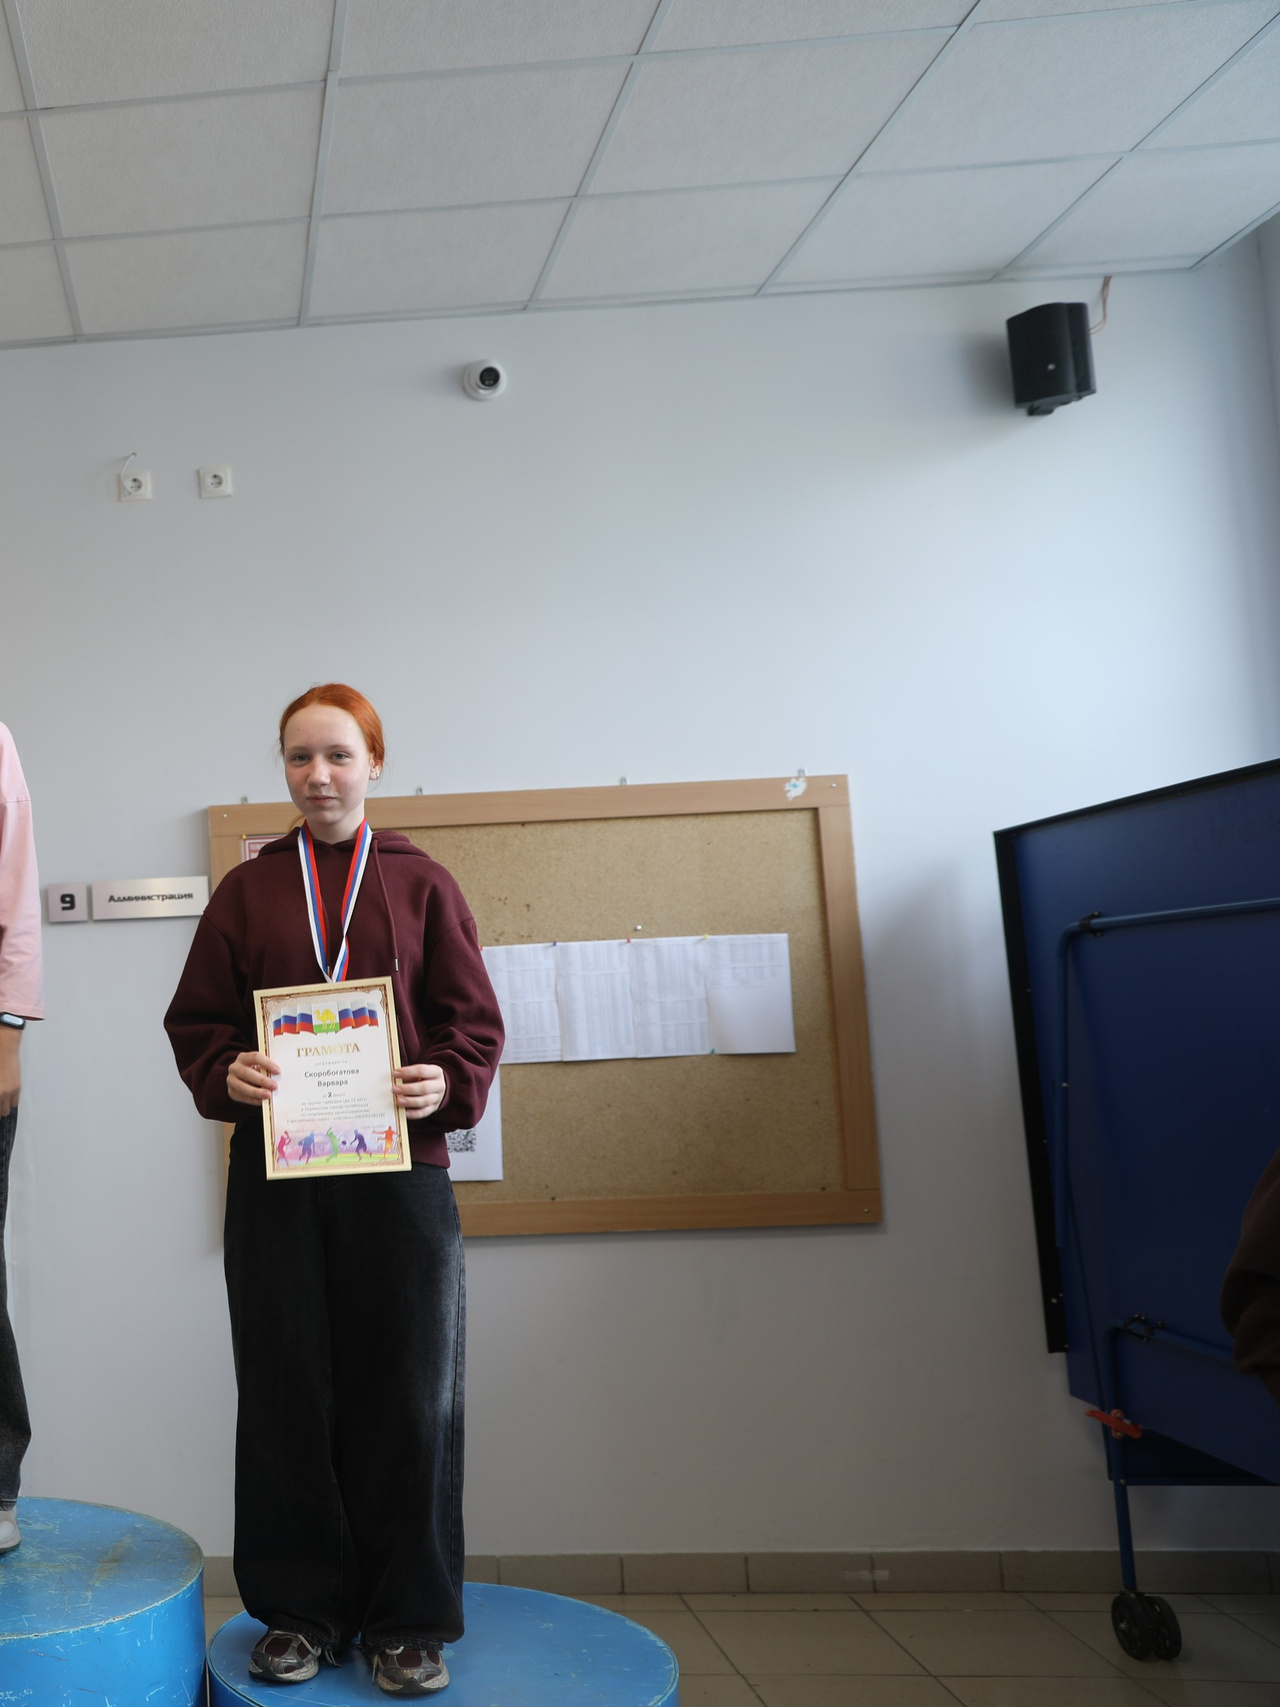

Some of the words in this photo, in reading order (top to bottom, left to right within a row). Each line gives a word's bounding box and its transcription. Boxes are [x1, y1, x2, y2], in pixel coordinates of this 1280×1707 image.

[60, 893, 76, 911] 9
[107, 892, 194, 903] Администрация
[296, 1043, 361, 1058] ГРАМОТА
[304, 1068, 360, 1078] Скоробогатова
[317, 1080, 349, 1088] Варвара
